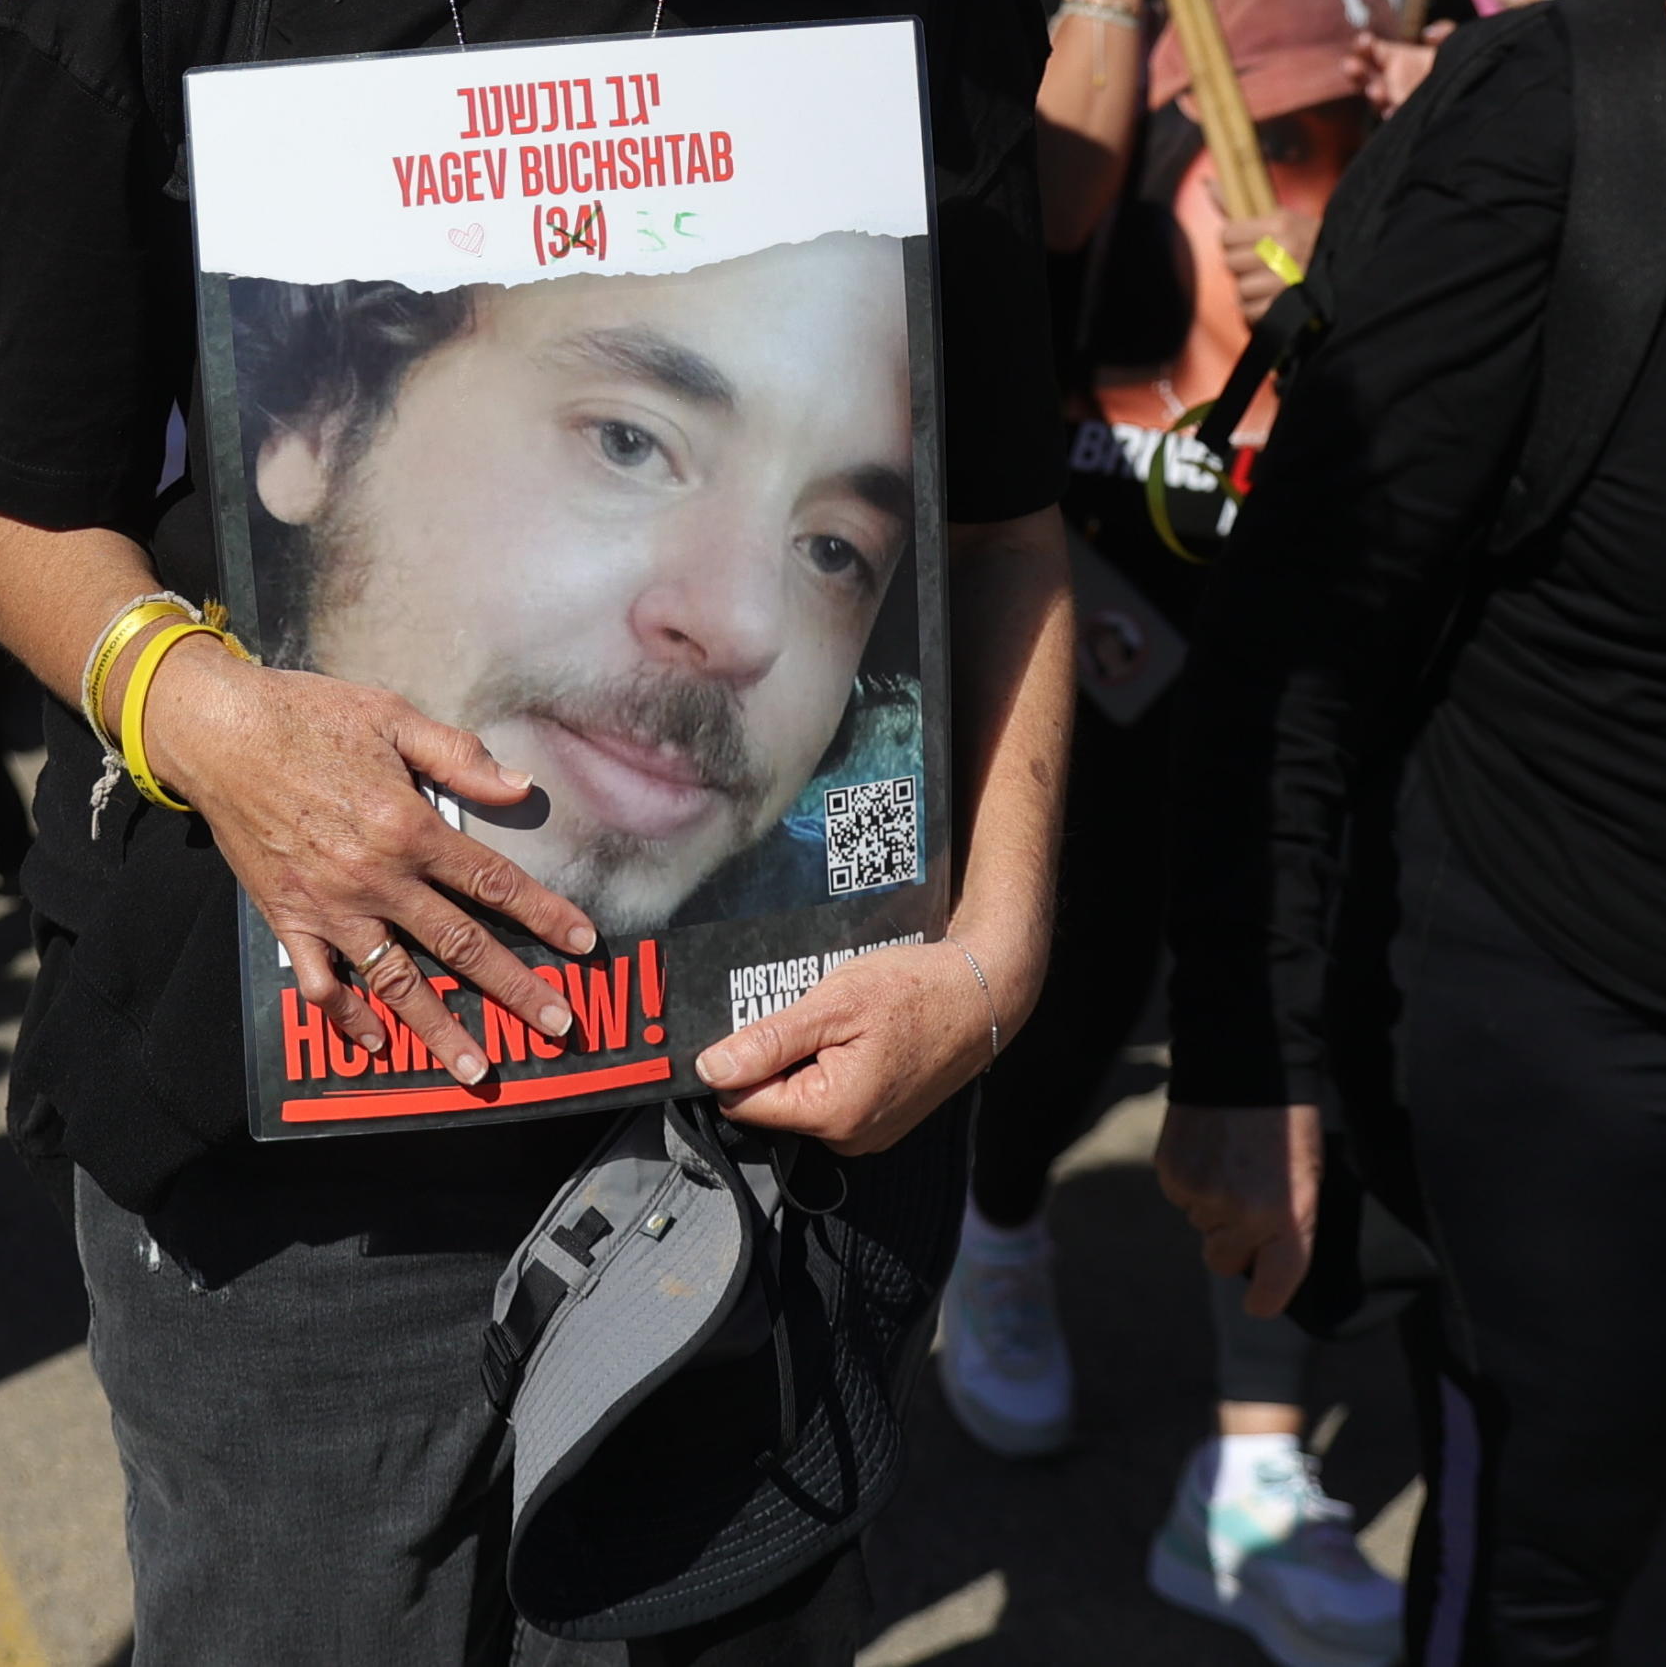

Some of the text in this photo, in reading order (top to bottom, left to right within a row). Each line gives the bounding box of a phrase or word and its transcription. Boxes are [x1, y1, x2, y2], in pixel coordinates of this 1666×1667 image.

[456, 72, 662, 140] יגב בוכשטב
[392, 130, 735, 208] YAGEV BUCHSHTAB
[532, 199, 608, 266] (34)
[729, 954, 820, 1001] HOSTAGES
